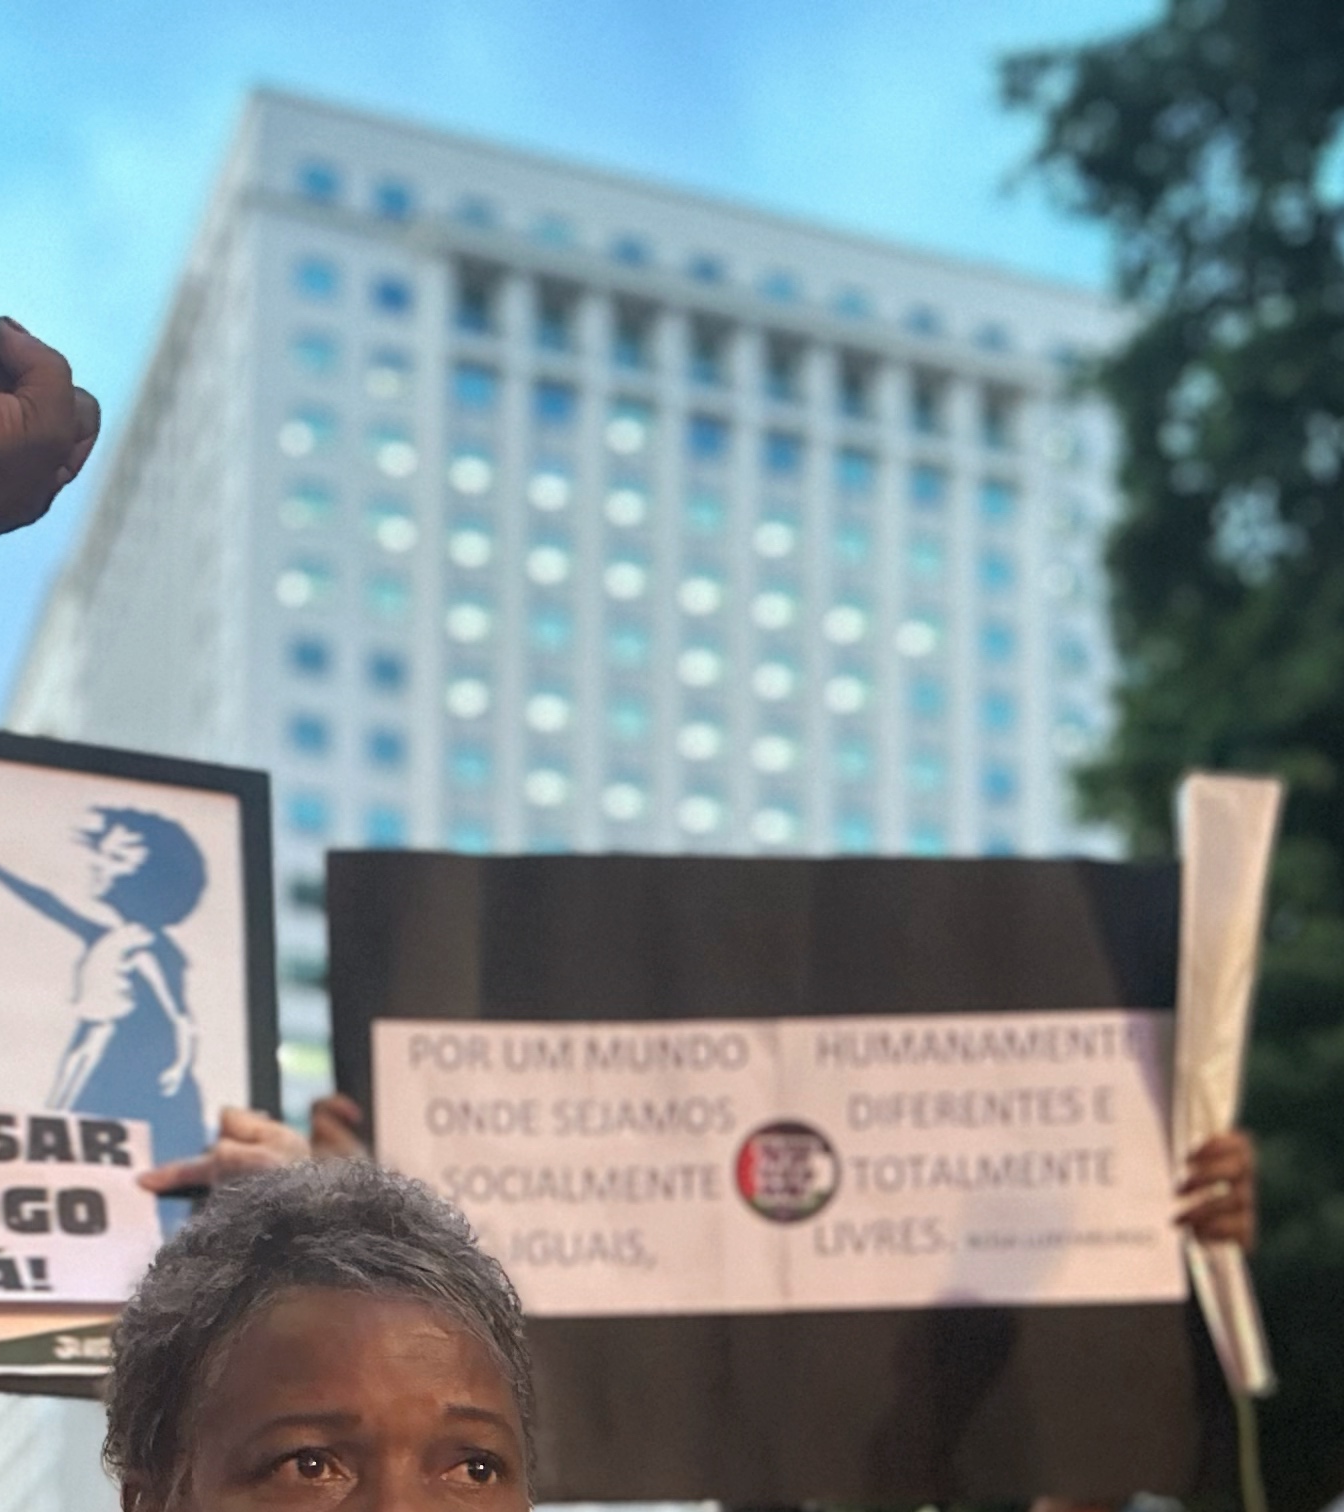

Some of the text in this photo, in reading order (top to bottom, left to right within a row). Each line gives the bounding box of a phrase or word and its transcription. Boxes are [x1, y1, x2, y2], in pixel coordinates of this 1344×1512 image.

[408, 1032, 750, 1073] POR UM MUNDO
[424, 1096, 737, 1136] ONDE SEJAMOS
[845, 1084, 1116, 1131] DIFERENTES E
[440, 1162, 722, 1204] SOCIALMENTE
[848, 1146, 1116, 1194] TOTALMENTE
